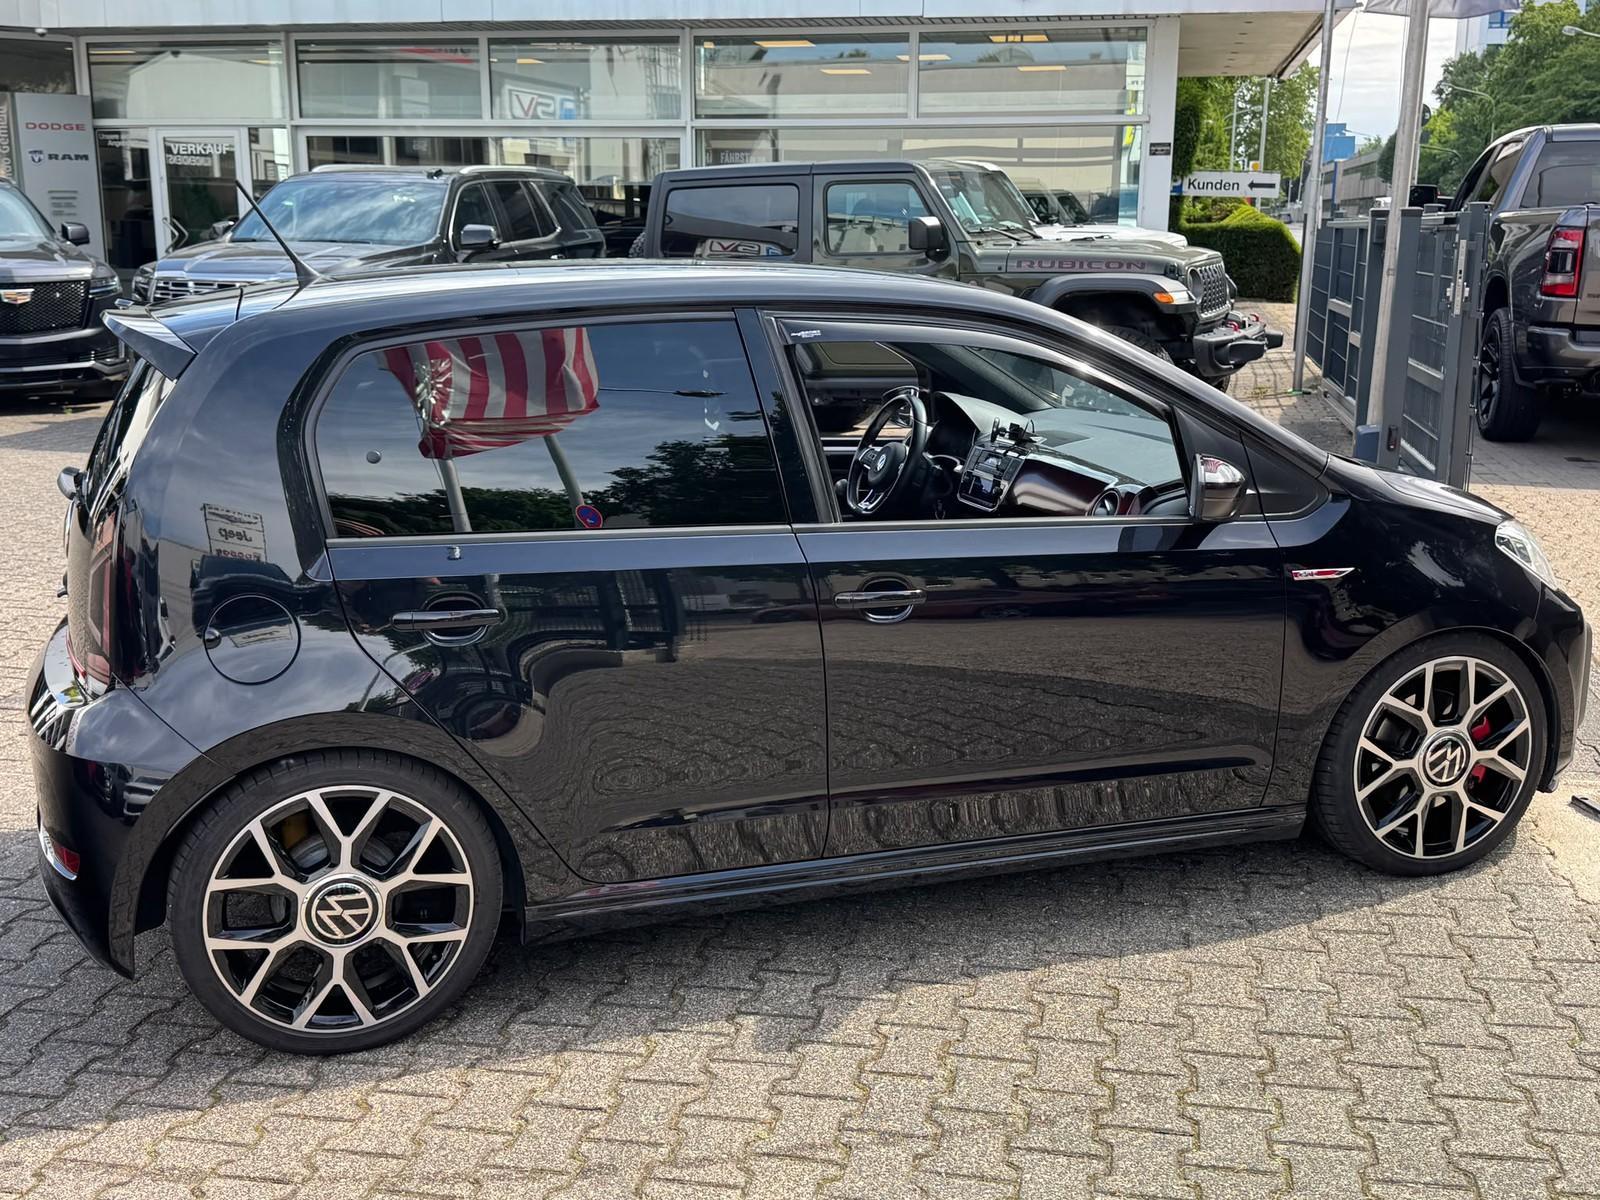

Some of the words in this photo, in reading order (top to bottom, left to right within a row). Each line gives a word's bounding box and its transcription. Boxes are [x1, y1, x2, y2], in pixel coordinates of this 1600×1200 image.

[25, 122, 86, 131] DODGE
[170, 143, 230, 155] VERKAUF
[47, 153, 89, 161] RAM
[1187, 178, 1240, 191] Kunden
[1016, 259, 1146, 270] RUBICON
